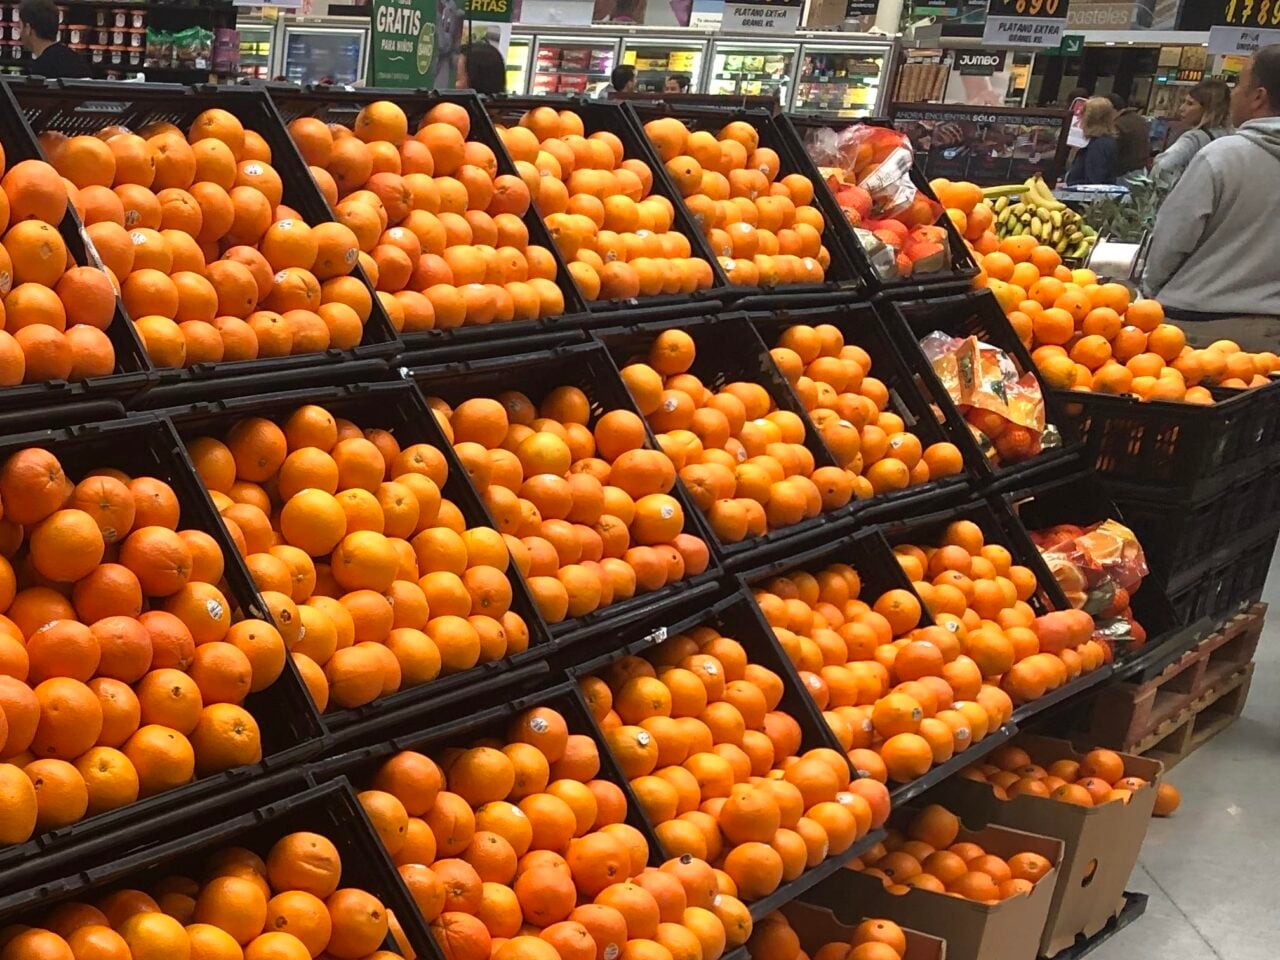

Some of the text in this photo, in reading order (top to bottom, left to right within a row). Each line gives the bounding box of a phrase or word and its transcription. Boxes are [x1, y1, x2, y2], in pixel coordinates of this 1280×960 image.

[734, 8, 763, 17] PLATANO
[376, 6, 421, 36] GRATIS
[742, 19, 764, 27] GRANEL
[998, 23, 1060, 35] PLATANO EXTRA
[381, 39, 395, 51] PARA
[959, 55, 1000, 66] JUMBO
[896, 111, 923, 119] AHORA
[925, 112, 970, 121] ENCUENTRA
